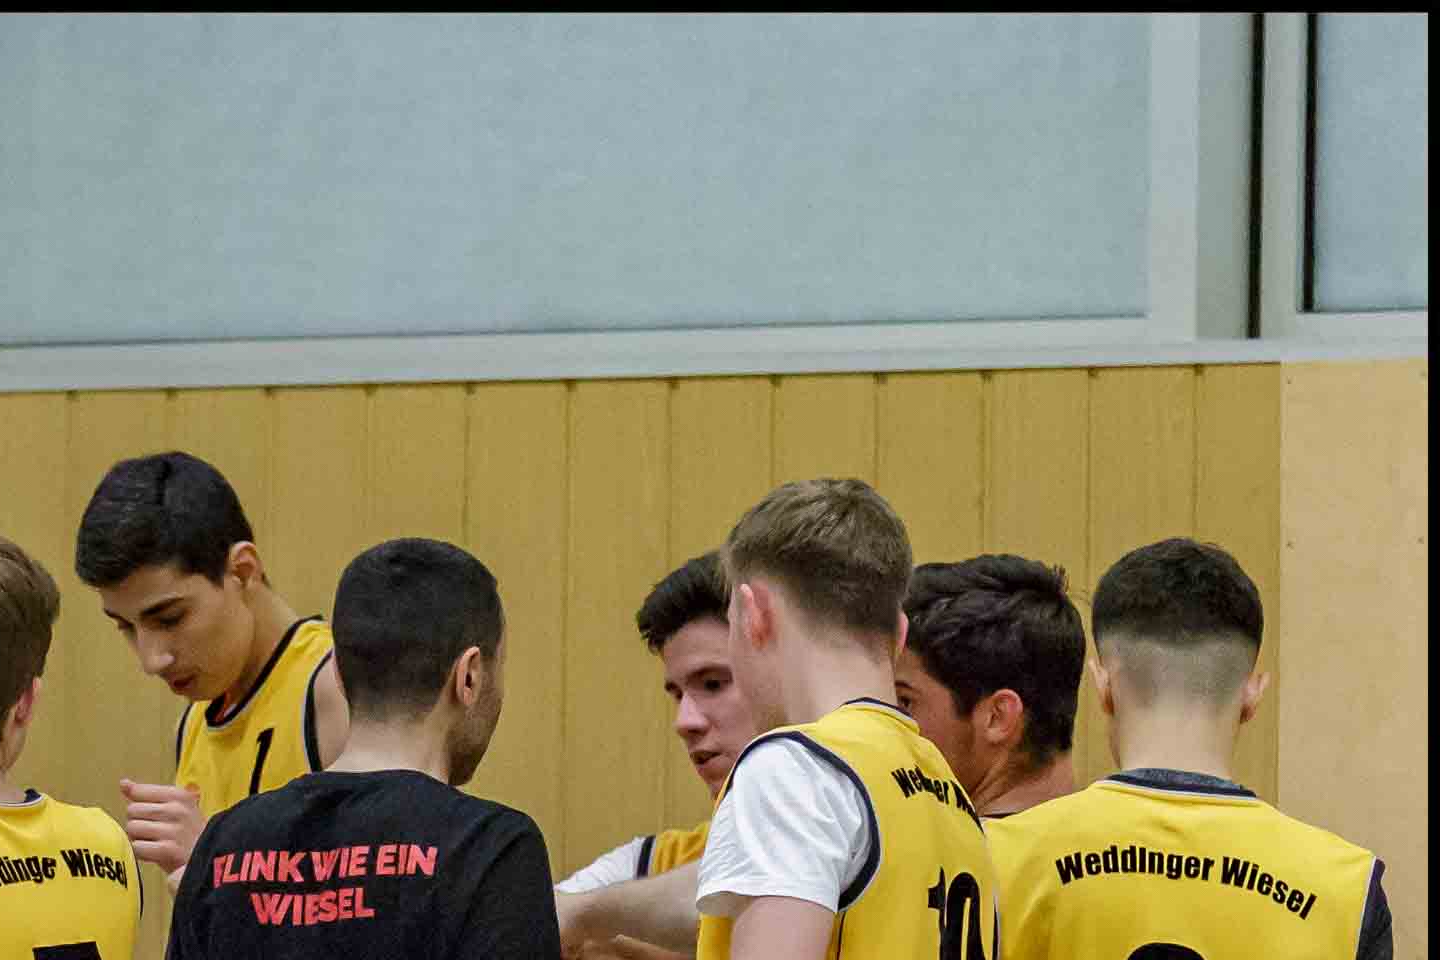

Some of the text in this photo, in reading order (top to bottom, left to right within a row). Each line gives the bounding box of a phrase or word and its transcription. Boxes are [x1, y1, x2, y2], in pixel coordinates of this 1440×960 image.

[312, 845, 369, 881] WIE
[376, 844, 438, 876] EIN
[1056, 845, 1317, 921] Weddinger Wiesel
[250, 888, 375, 926] WIESEL
